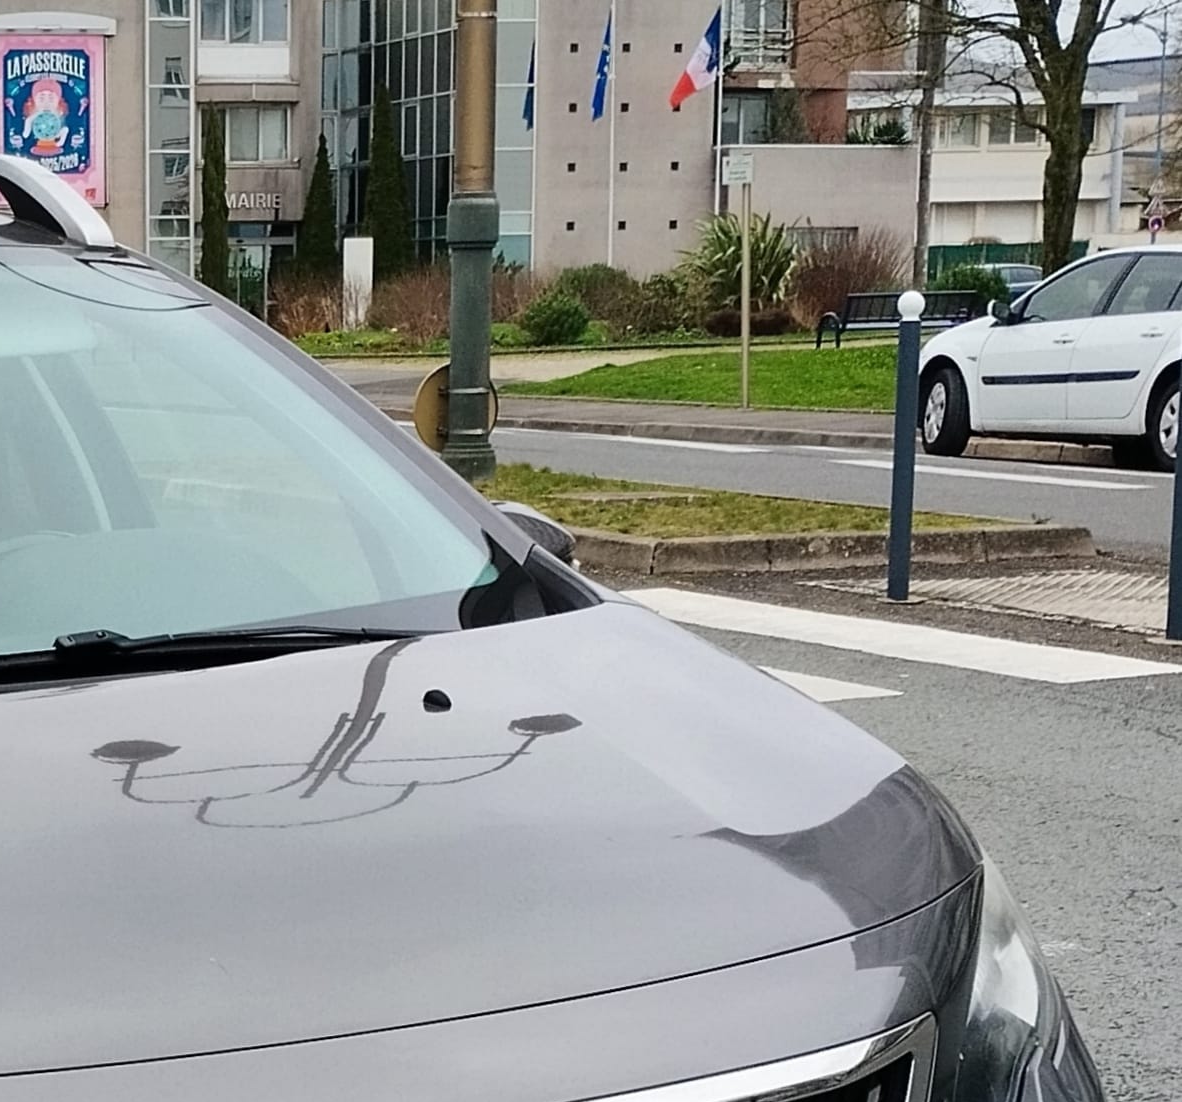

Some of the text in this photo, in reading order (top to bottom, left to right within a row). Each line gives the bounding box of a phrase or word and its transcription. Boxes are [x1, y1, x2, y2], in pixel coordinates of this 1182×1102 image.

[7, 57, 20, 79] LA
[22, 52, 85, 79] PASSERELLE
[225, 193, 282, 208] MAIRIE
